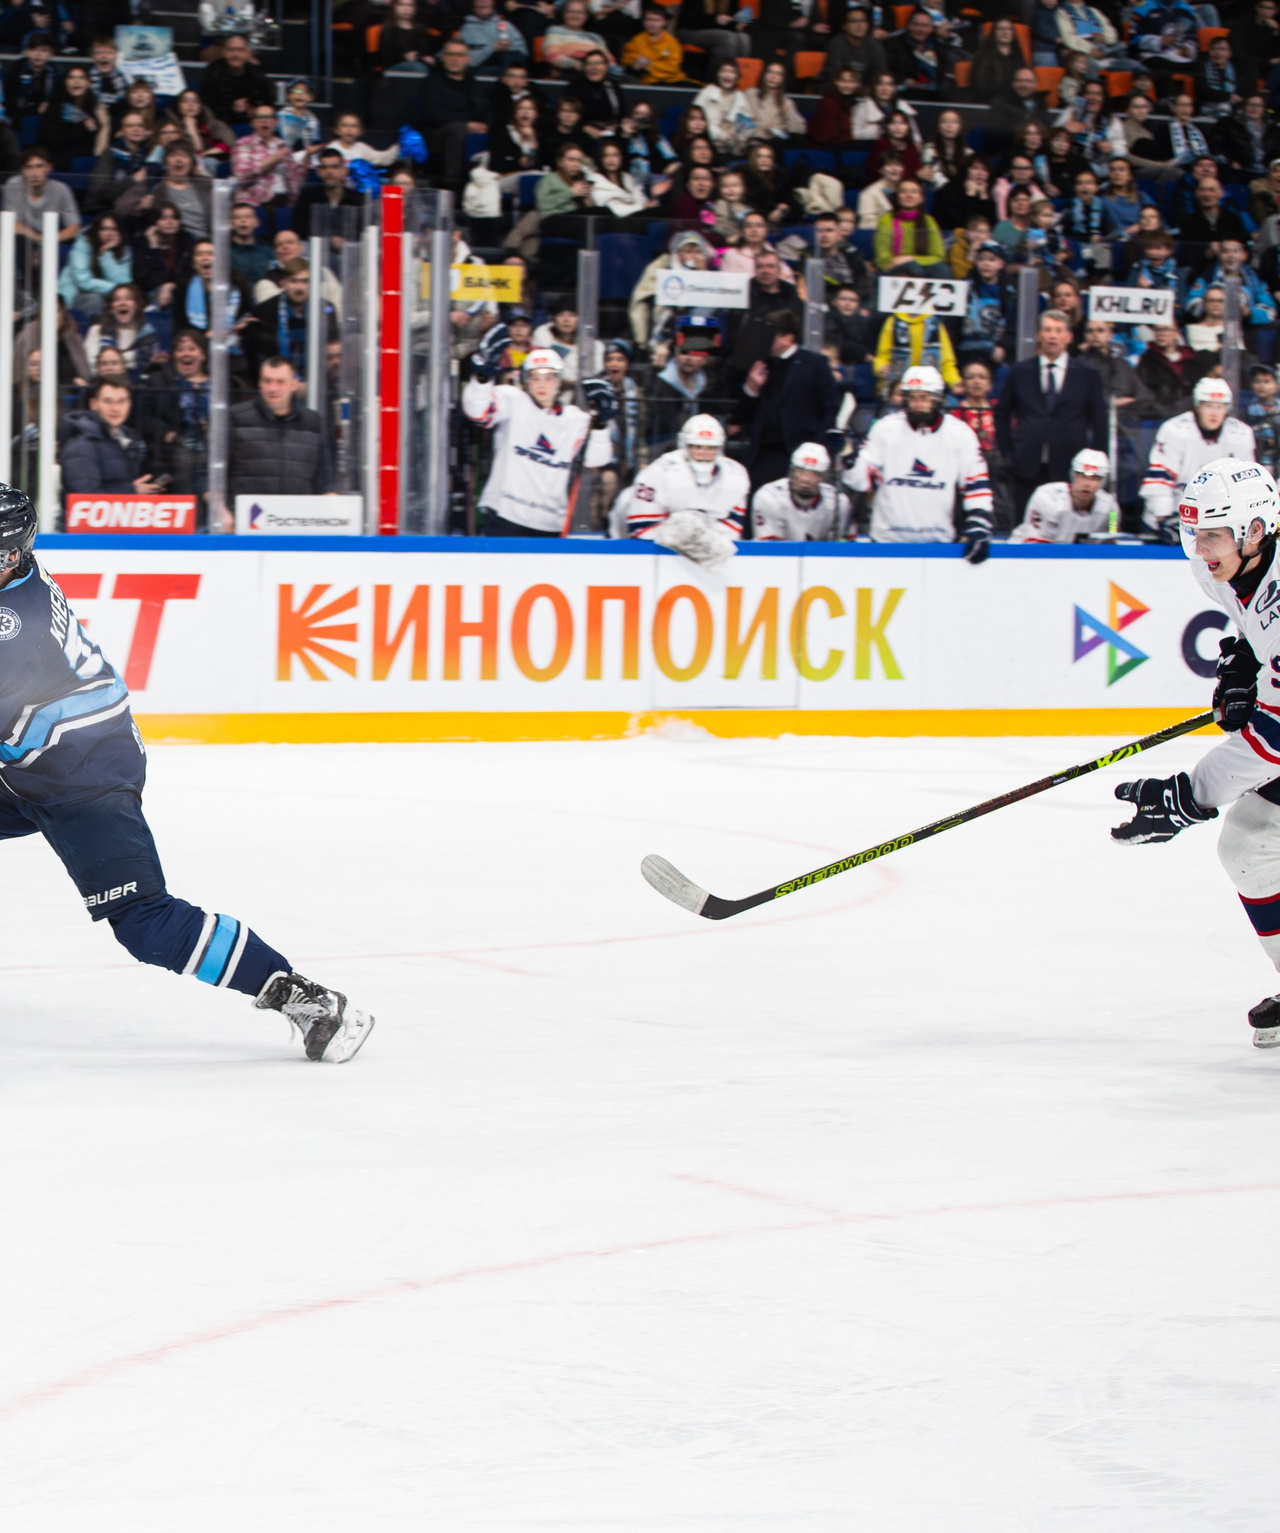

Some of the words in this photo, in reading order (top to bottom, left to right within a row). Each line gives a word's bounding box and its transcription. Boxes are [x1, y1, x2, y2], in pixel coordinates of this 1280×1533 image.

[464, 276, 511, 289] БАНК
[1095, 295, 1168, 315] KHL.RU
[1233, 469, 1260, 482] LADA
[1249, 499, 1269, 509] CCM
[69, 501, 195, 528] FONBET
[267, 514, 351, 527] Ростелеком
[275, 583, 908, 683] КИНОПОИСК
[774, 833, 915, 899] SHERWOOD
